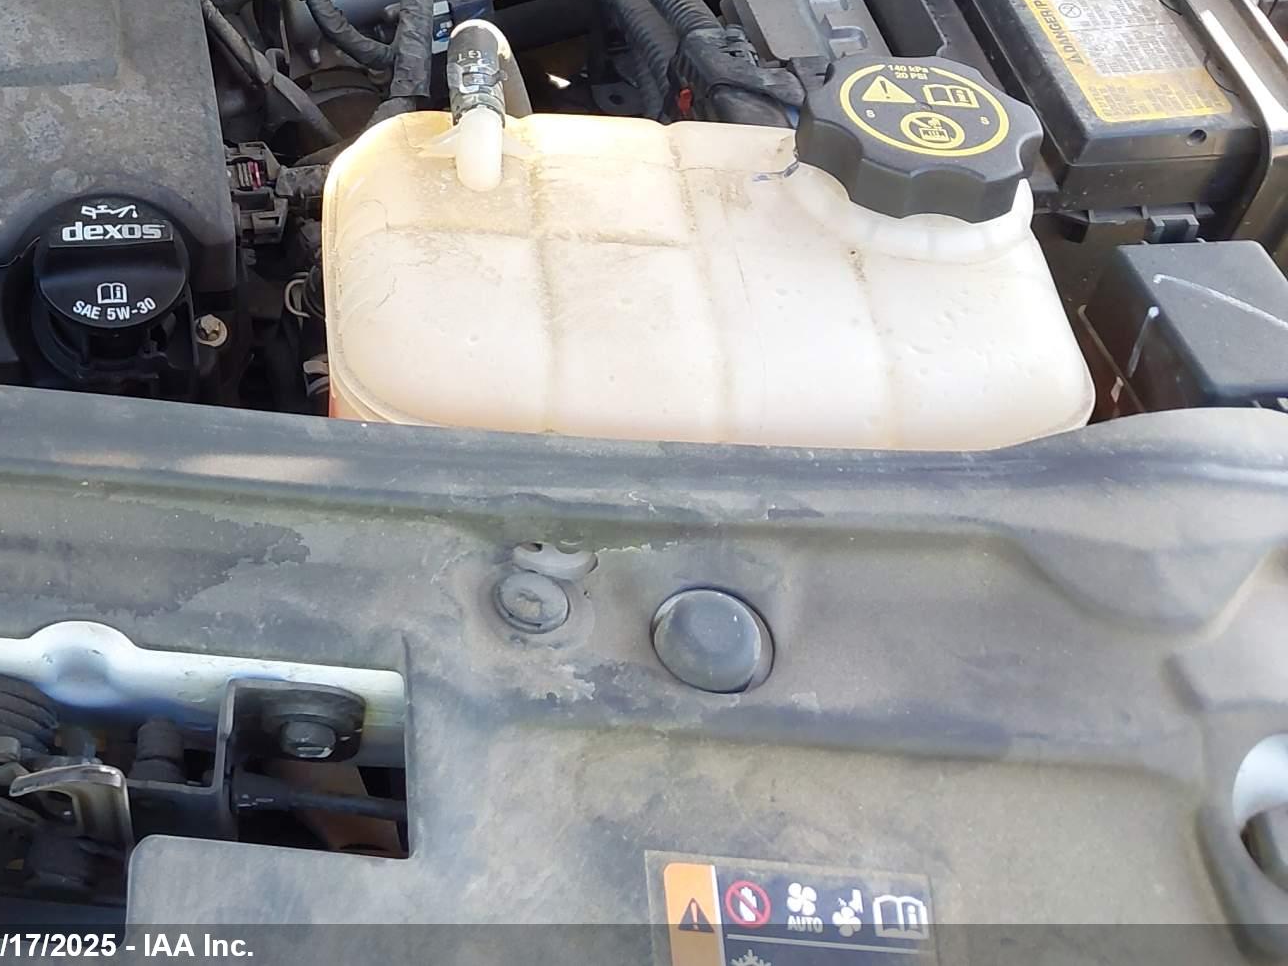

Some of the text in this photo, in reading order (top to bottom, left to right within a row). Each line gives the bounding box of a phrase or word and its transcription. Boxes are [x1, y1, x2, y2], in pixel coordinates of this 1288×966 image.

[888, 64, 929, 74] 140 kPa
[910, 72, 928, 80] PSI
[62, 221, 165, 241] dexos
[73, 297, 156, 321] SAE 5W-30
[787, 915, 824, 933] AUTO
